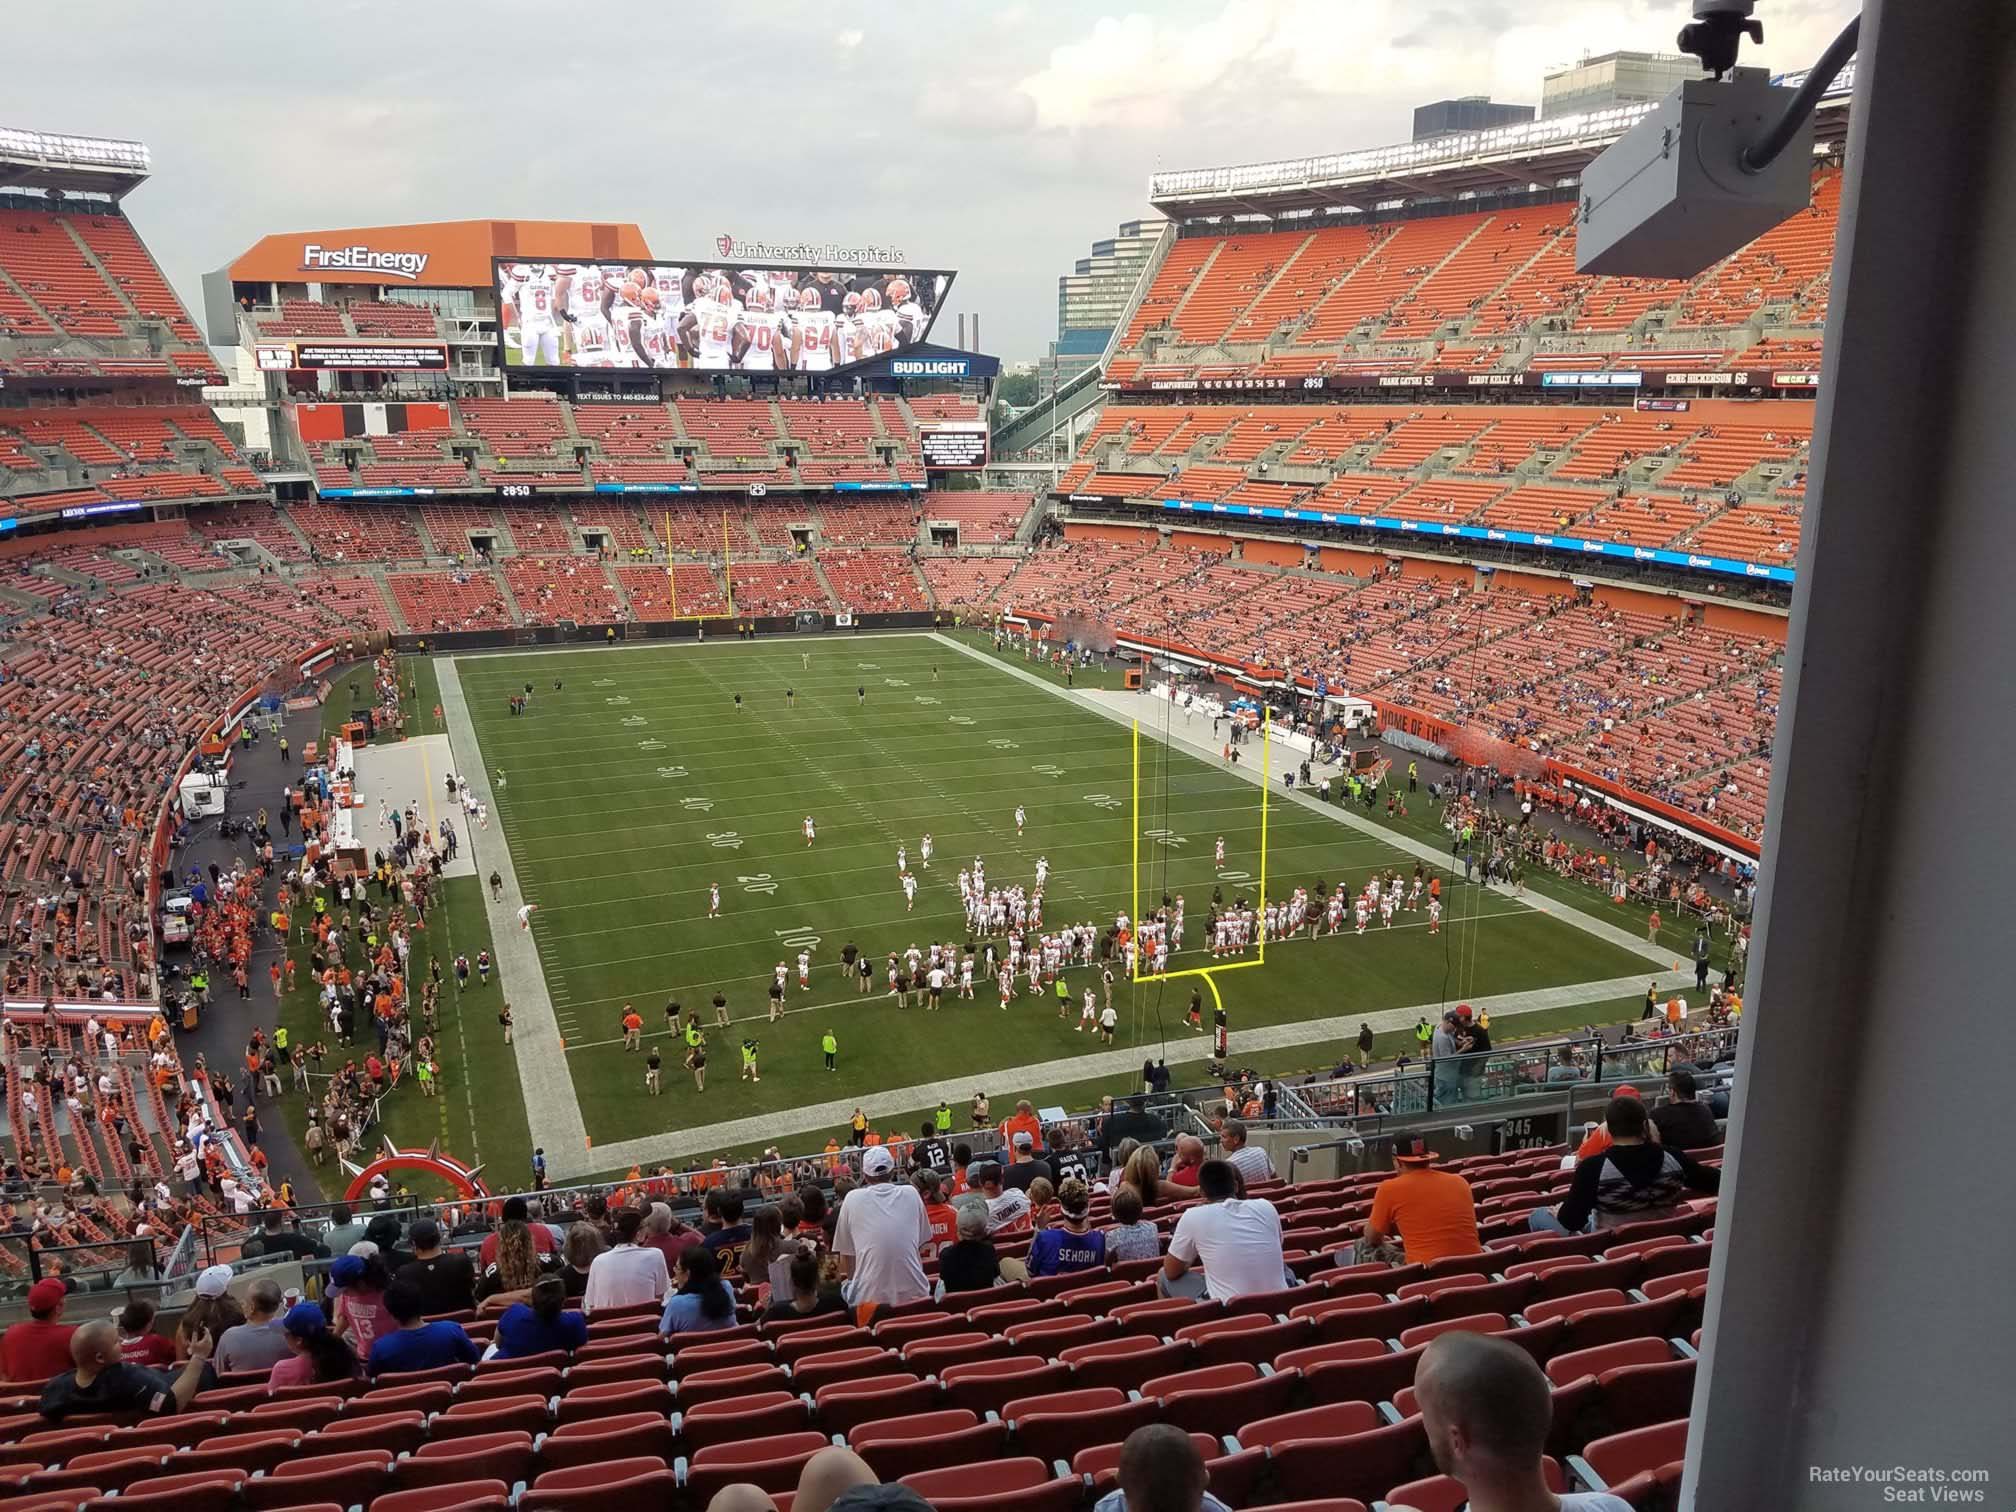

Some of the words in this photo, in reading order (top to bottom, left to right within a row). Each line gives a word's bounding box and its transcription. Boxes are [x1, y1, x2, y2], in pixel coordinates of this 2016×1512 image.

[304, 245, 428, 273] FirstEnergy
[734, 242, 821, 264] University
[826, 245, 904, 264] Hospitals
[893, 362, 924, 374] BUD
[925, 362, 966, 374] LIGHT
[177, 378, 207, 386] KeyBank
[1490, 375, 1511, 384] KELLY
[1513, 374, 1524, 384] 44
[1734, 372, 1748, 384] 66
[1380, 708, 1408, 732] HOME
[1411, 719, 1423, 736] OF
[1083, 794, 1122, 809] 30
[706, 831, 743, 848] 30
[736, 873, 779, 893] 20
[775, 926, 822, 948] 10
[1507, 1119, 1532, 1137] 345
[928, 1148, 945, 1168] 12
[996, 1200, 1021, 1221] THOMAS
[1059, 1248, 1097, 1263] SEHORN
[353, 1318, 375, 1339] 13
